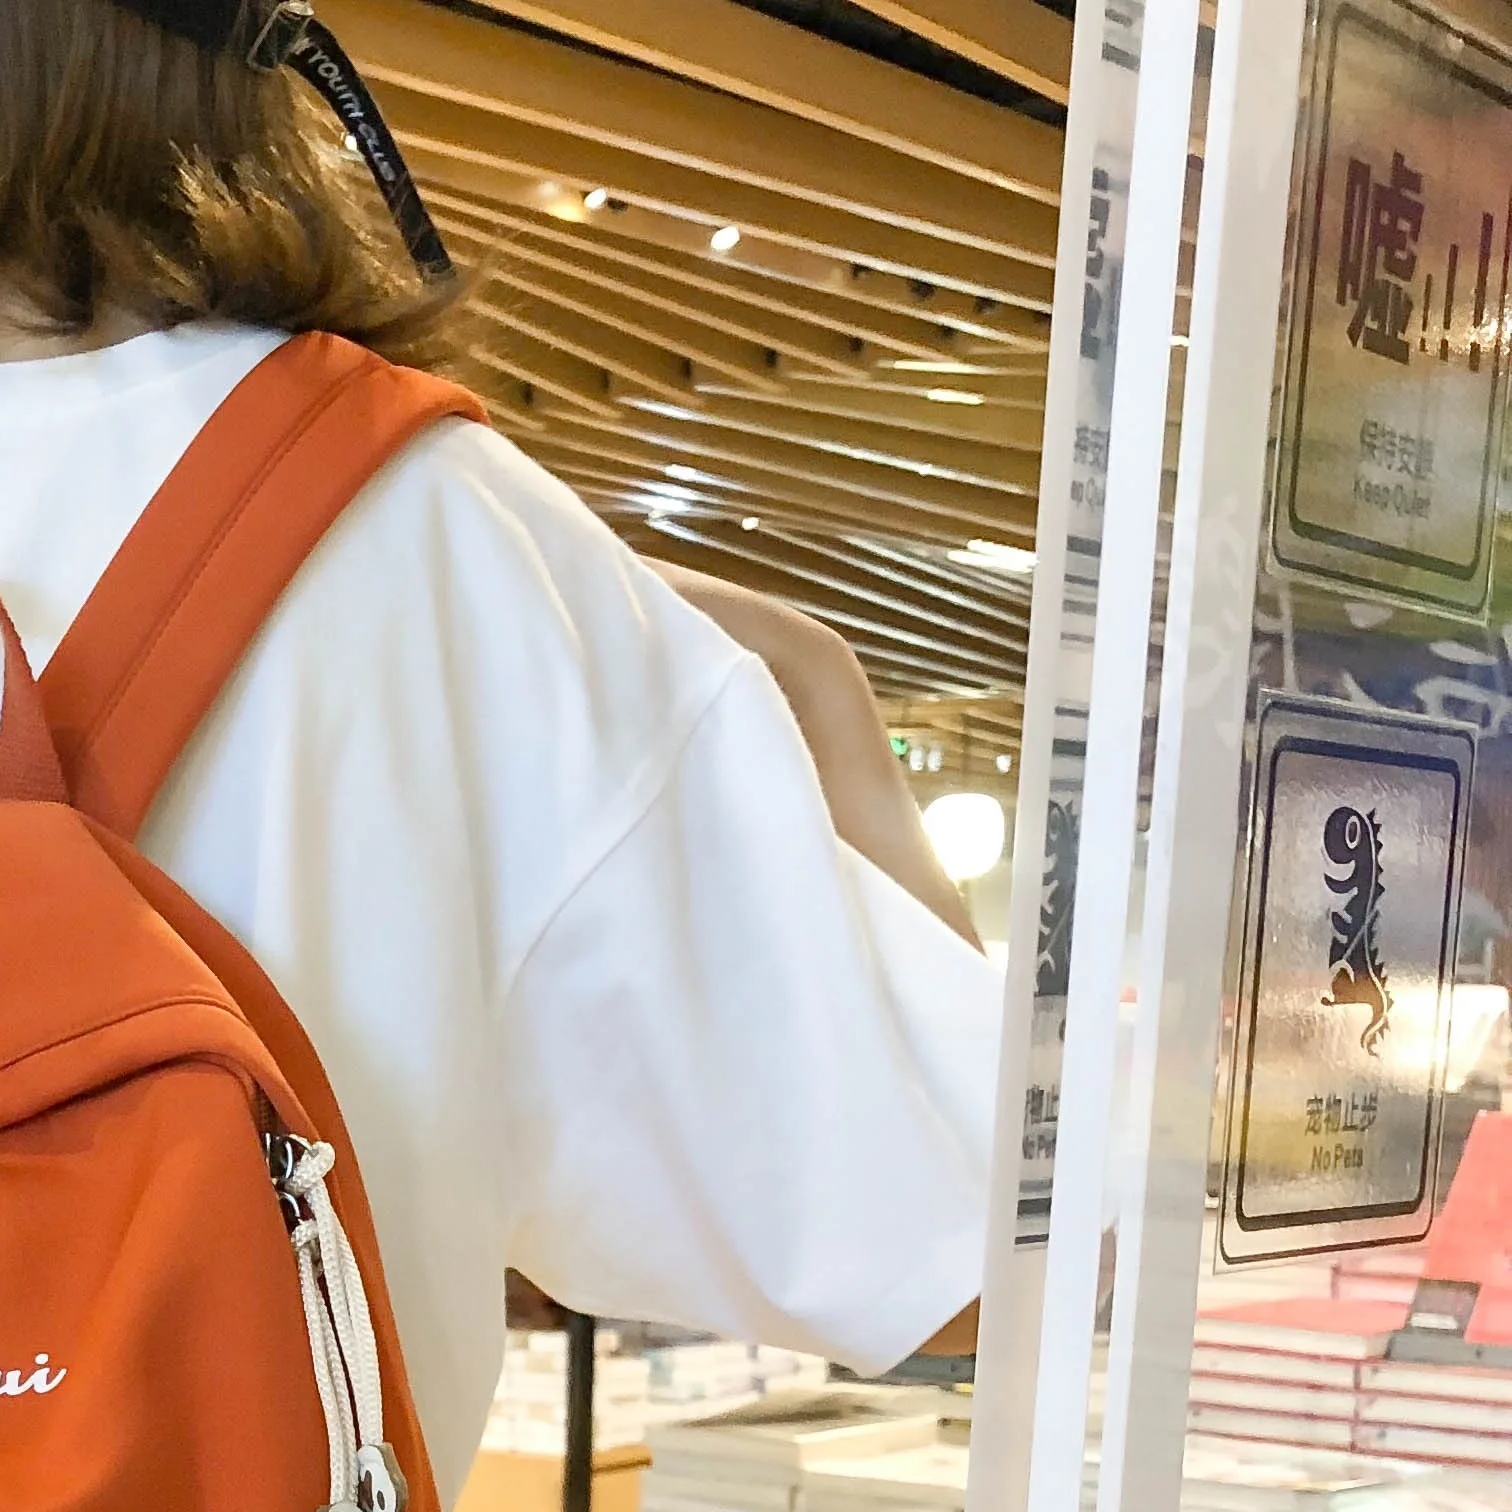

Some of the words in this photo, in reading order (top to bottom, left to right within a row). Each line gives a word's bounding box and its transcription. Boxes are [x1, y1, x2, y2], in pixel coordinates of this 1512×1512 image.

[1303, 1088, 1379, 1136] 宠物止步
[1311, 1145, 1332, 1171] No
[1334, 1143, 1364, 1169] Pets
